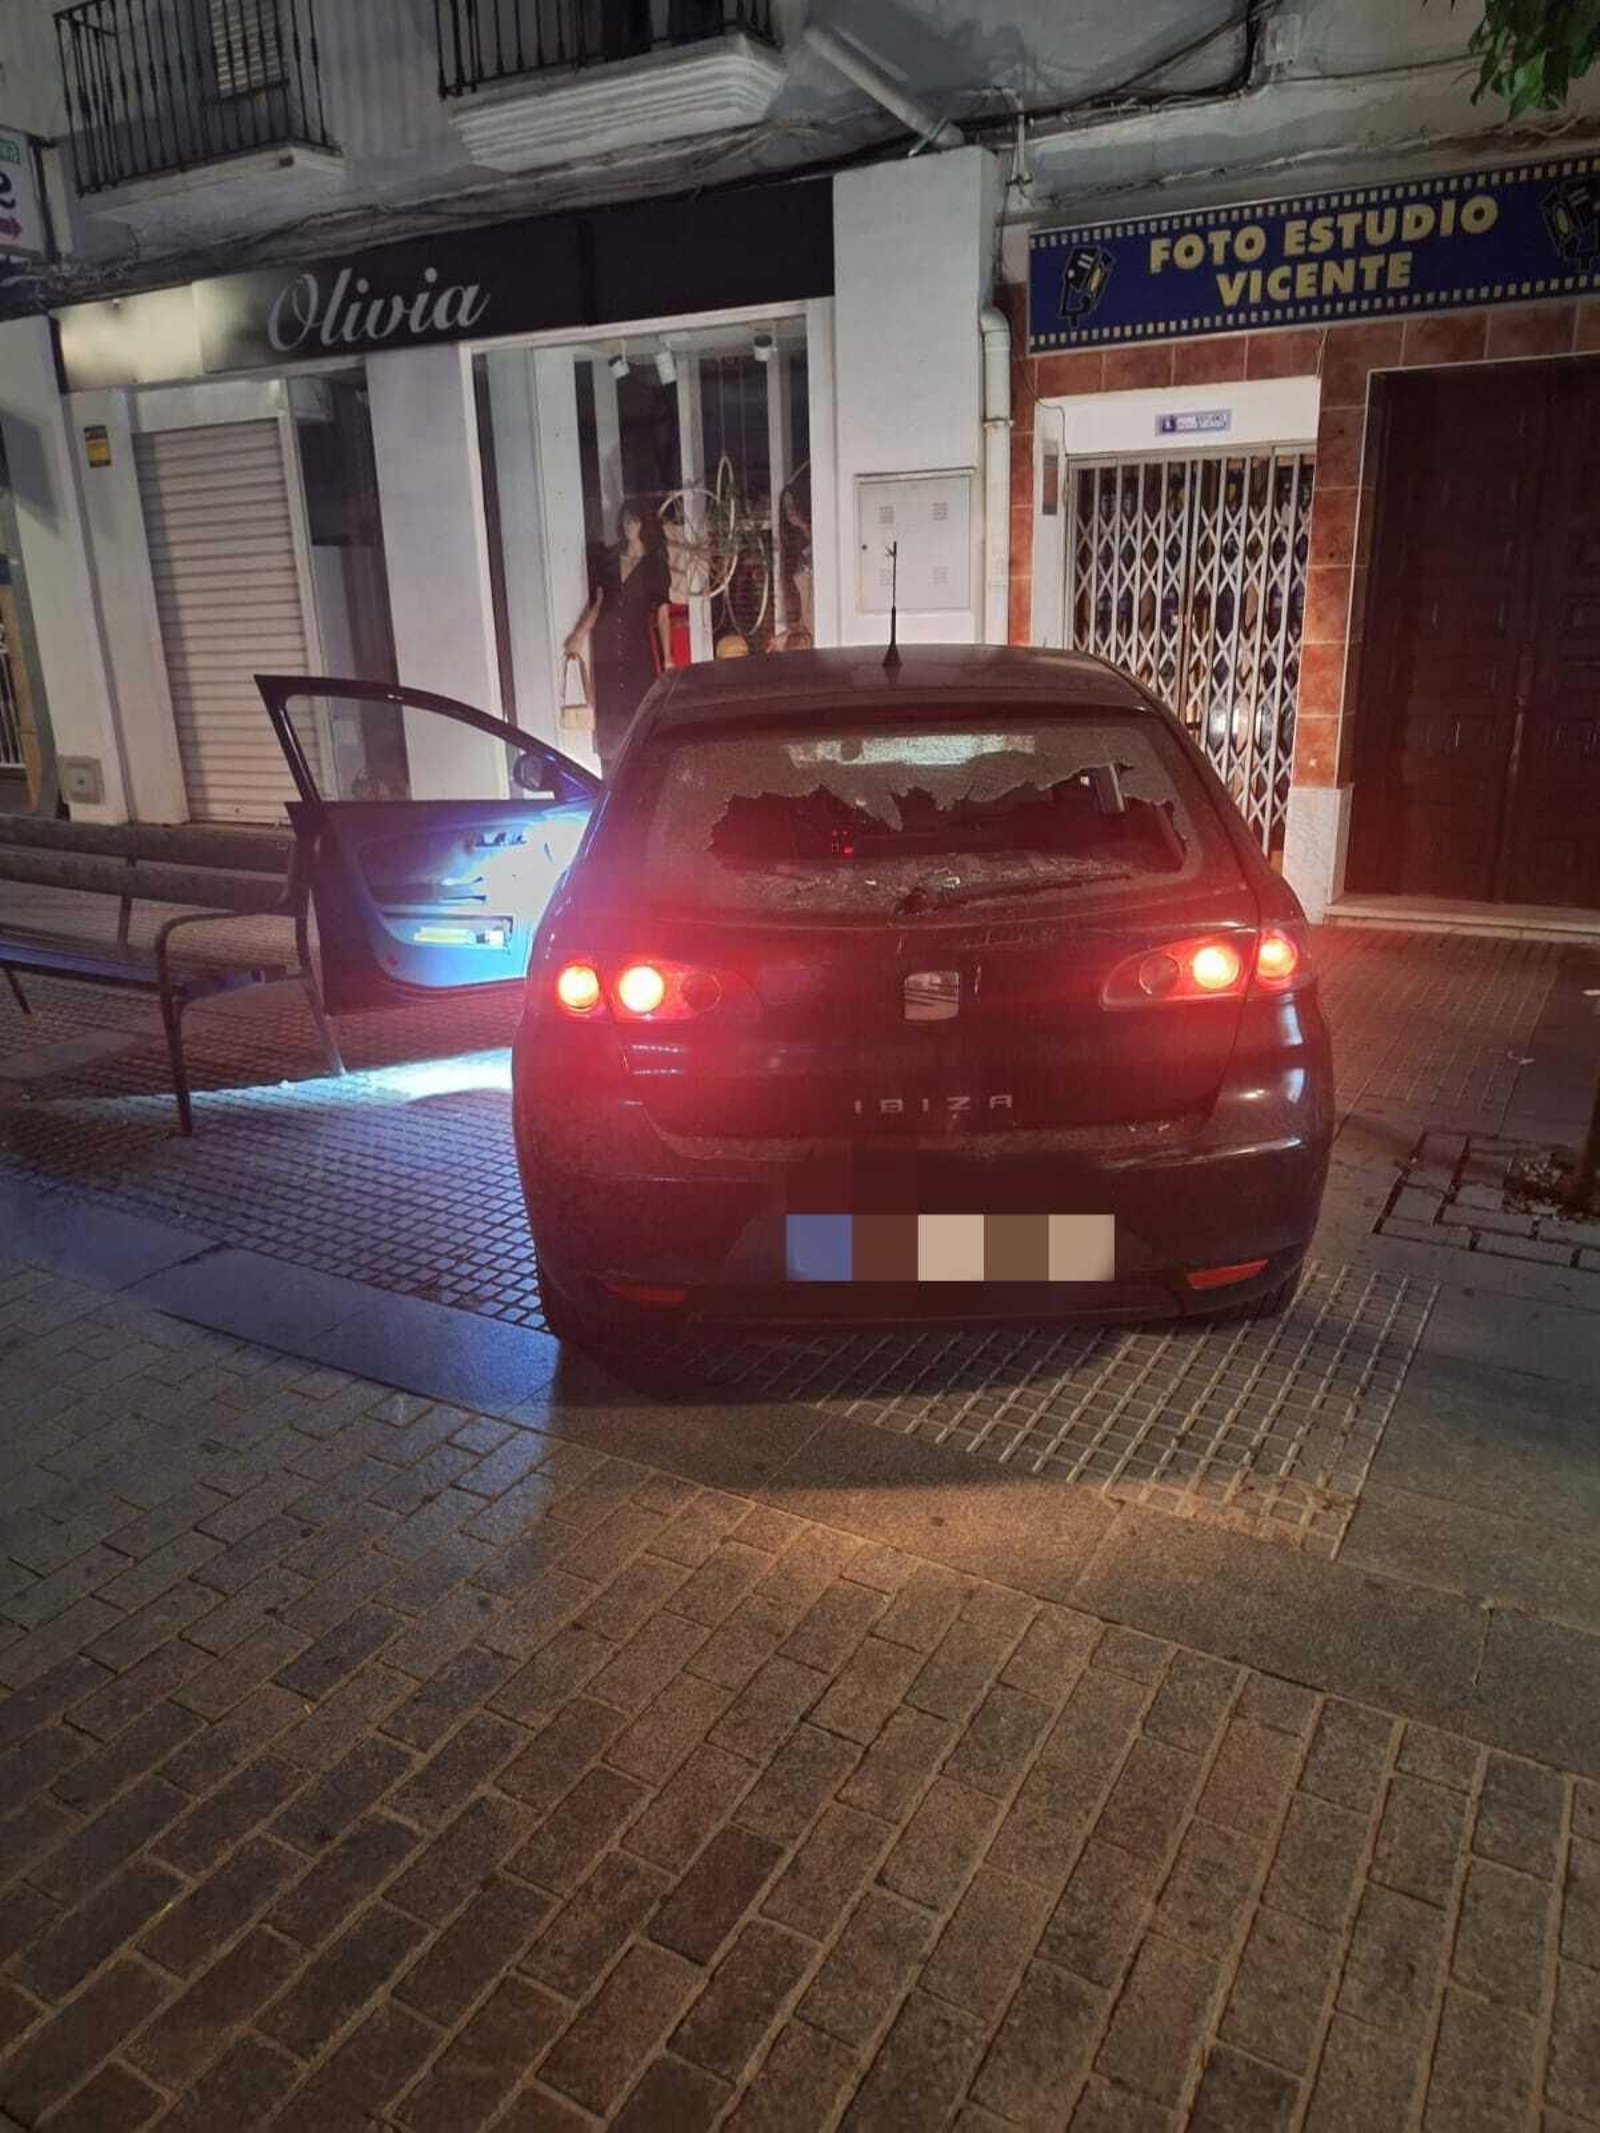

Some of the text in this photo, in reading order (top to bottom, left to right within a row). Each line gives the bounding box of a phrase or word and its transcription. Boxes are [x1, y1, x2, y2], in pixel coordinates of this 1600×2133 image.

[1149, 195, 1499, 274] FOTO ESTUDIO
[267, 266, 491, 351] Olivia
[1215, 251, 1413, 307] VICENTE
[854, 1094, 1013, 1115] IBIZA
